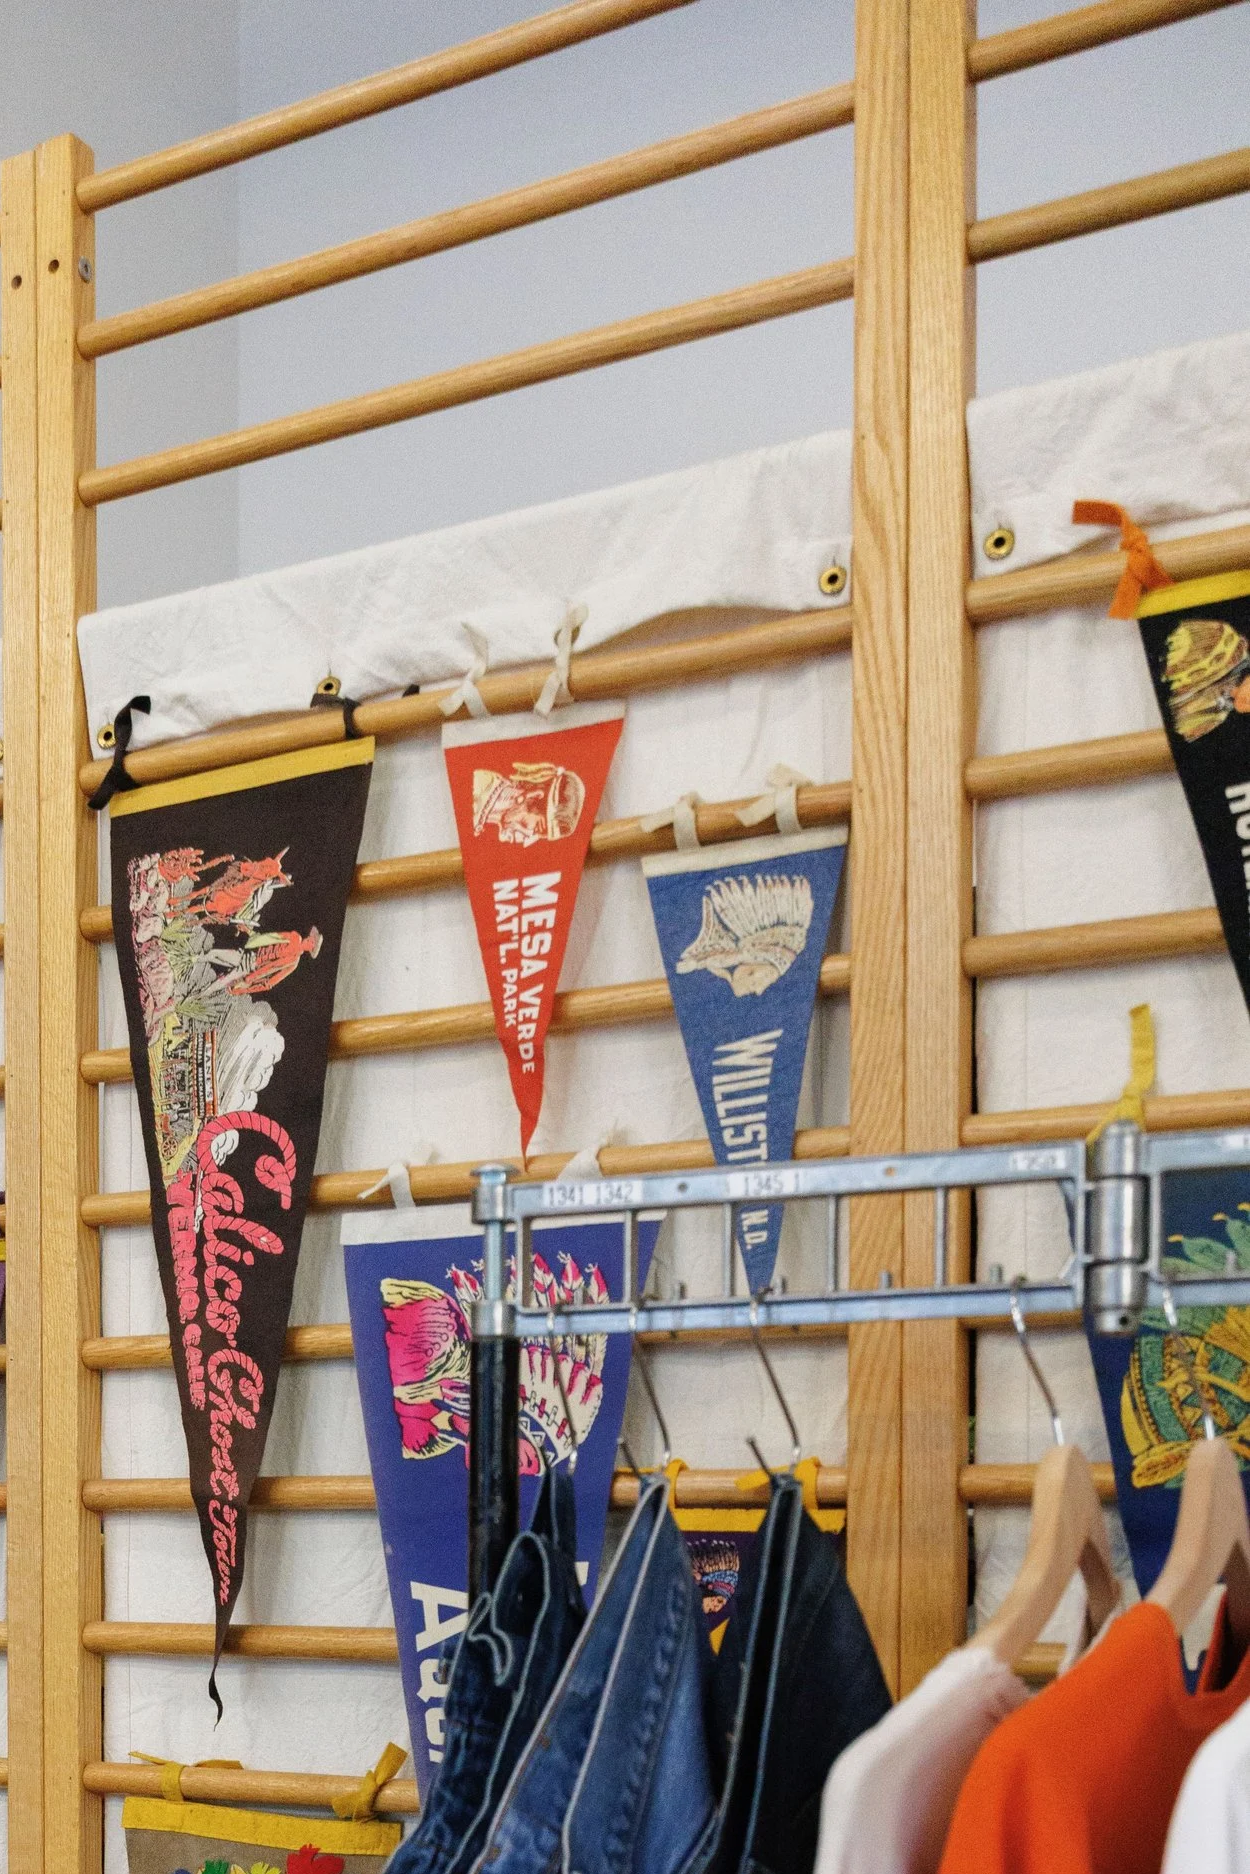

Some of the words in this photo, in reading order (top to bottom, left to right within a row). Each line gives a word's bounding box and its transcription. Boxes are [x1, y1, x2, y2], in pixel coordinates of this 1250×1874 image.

[517, 871, 561, 980] MESA
[502, 968, 517, 1028] PARK
[519, 981, 542, 1074] VERDE
[197, 1111, 297, 1346] Calico
[207, 1349, 264, 1500] Ghost
